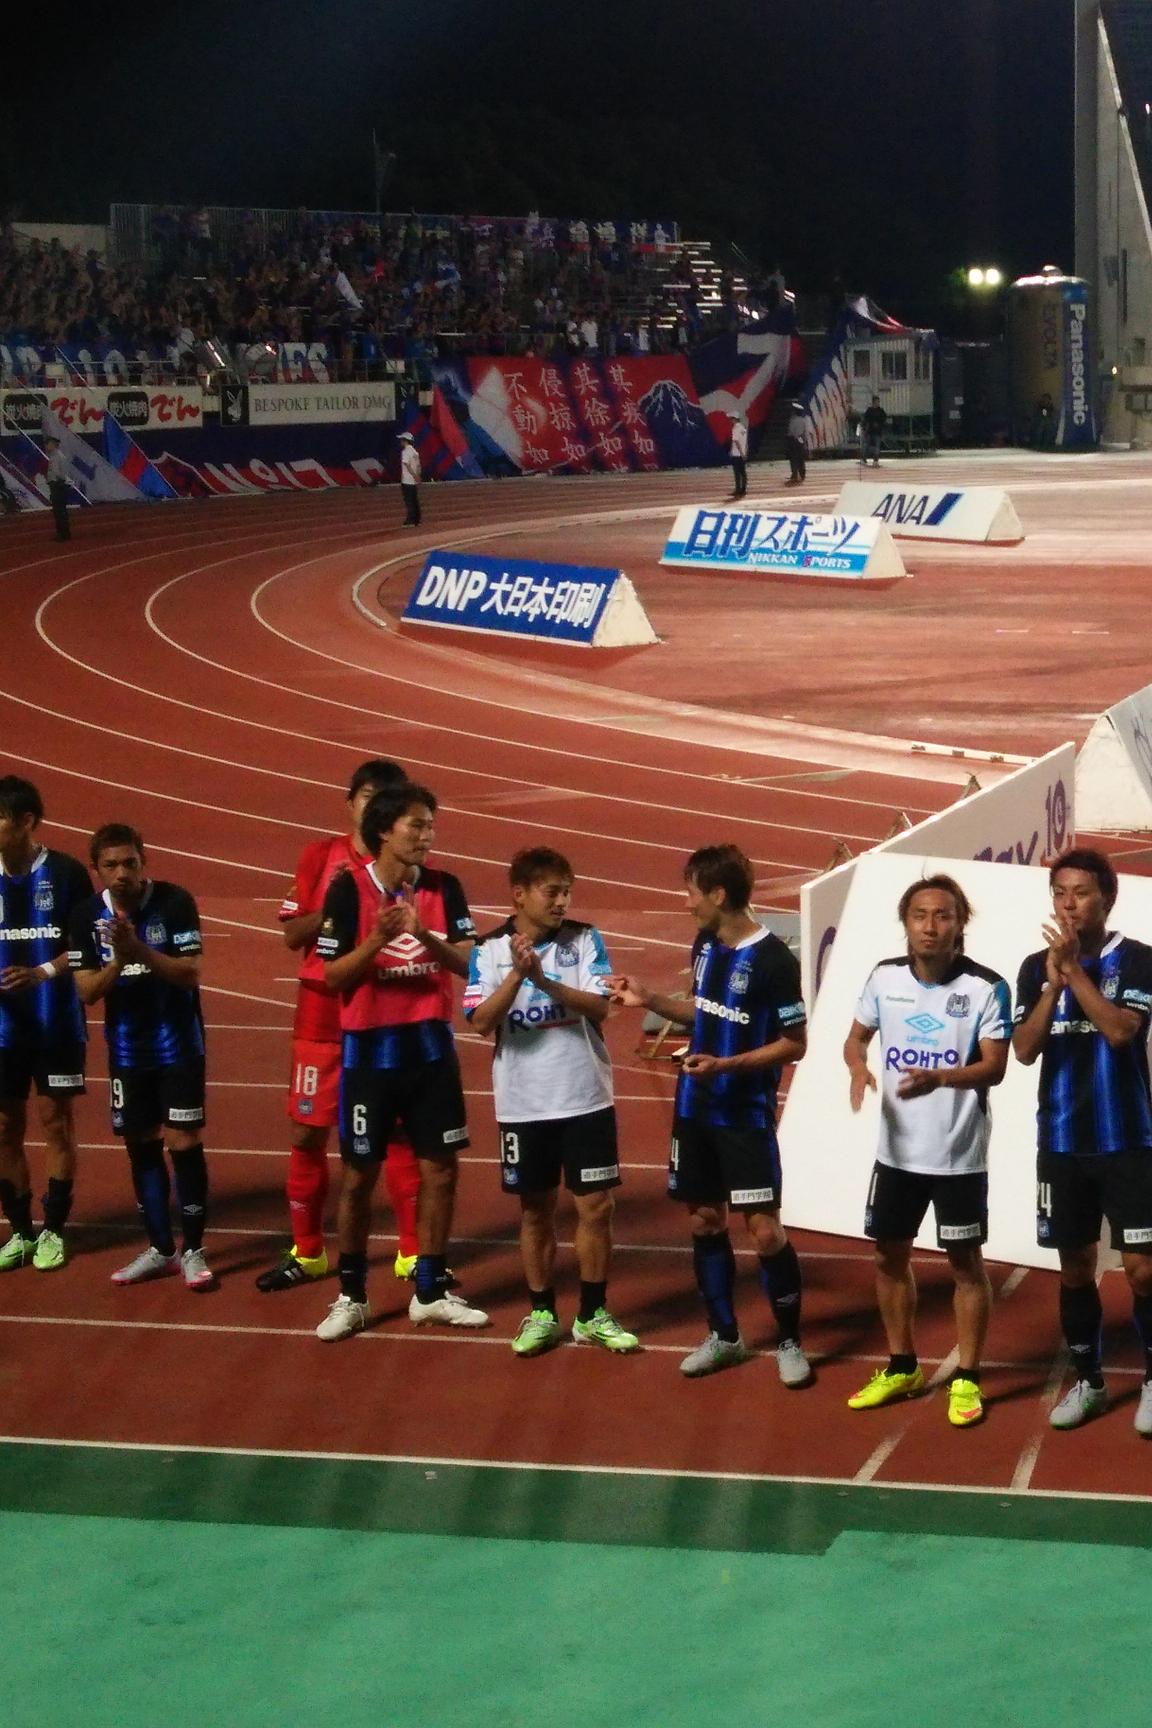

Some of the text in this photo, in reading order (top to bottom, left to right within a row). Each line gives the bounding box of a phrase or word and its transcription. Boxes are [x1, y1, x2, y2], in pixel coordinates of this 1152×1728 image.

[1070, 303, 1087, 426] Panasonic
[254, 398, 309, 412] BESPOKE
[315, 397, 359, 411] TAILOR
[871, 493, 930, 526] ANA
[683, 509, 862, 558] 日刊スポーツ
[749, 553, 852, 569] NIKKAN SPORTS
[416, 565, 606, 629] DNP 大日本印刷
[0, 923, 61, 940] nasonic
[378, 961, 441, 979] umbro
[886, 1046, 960, 1072] ROHTO
[295, 1062, 319, 1096] 18
[353, 1103, 367, 1135] 6
